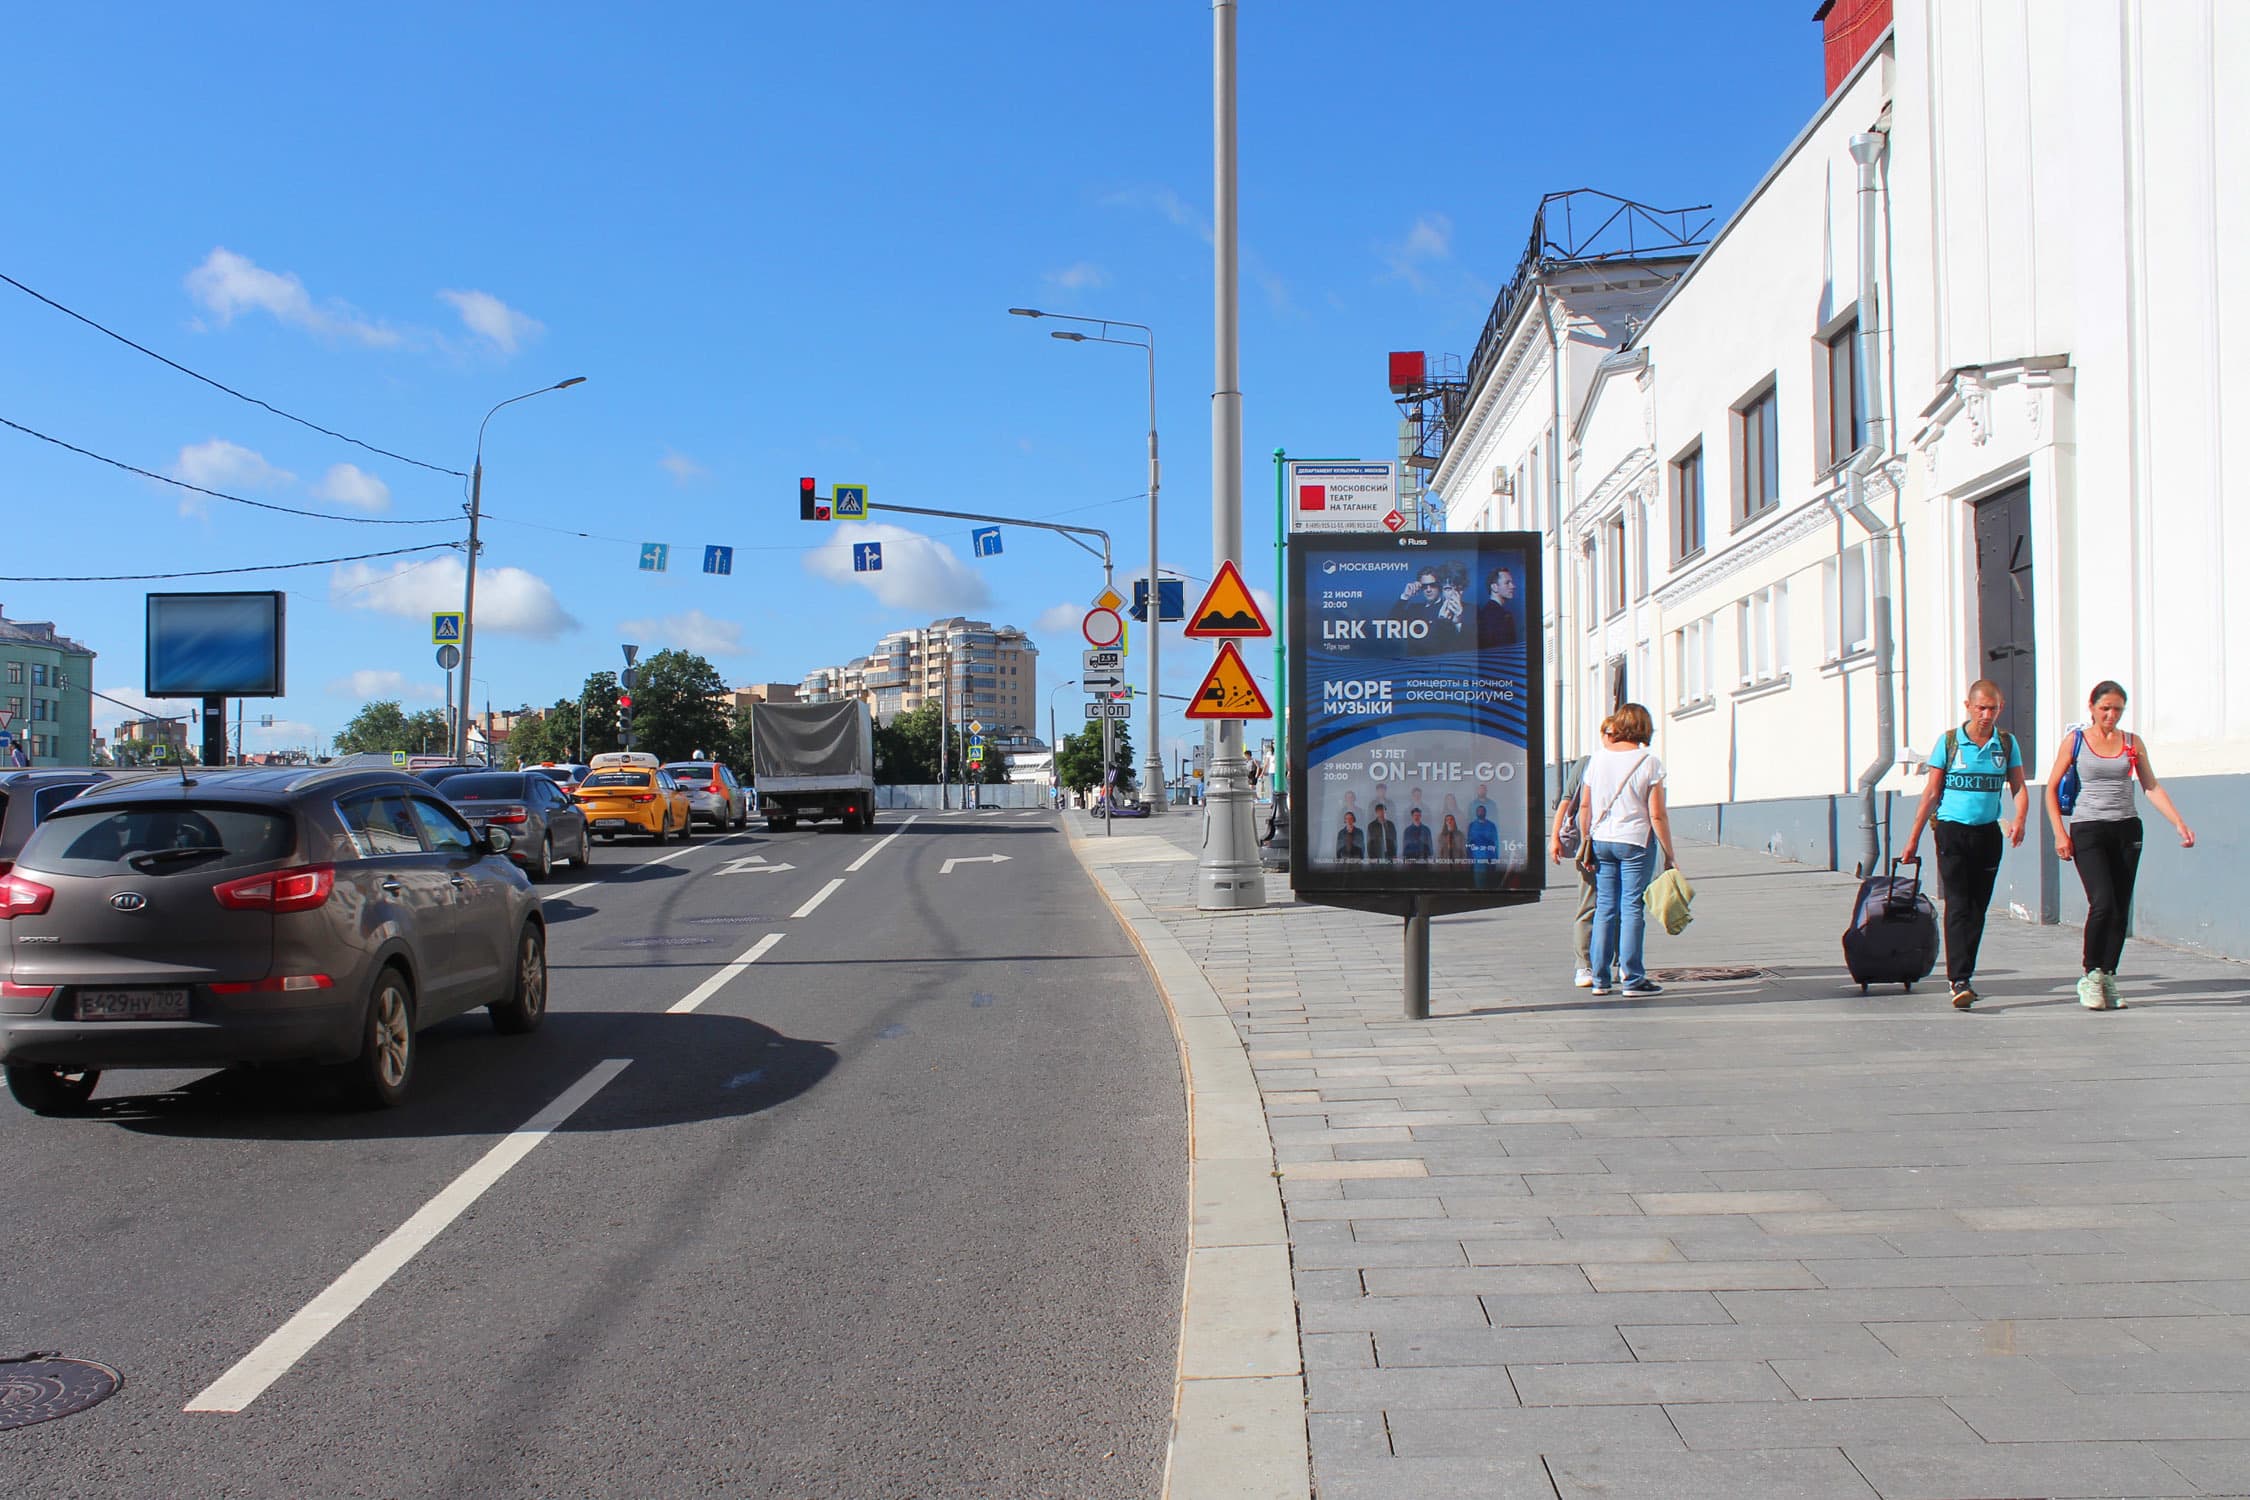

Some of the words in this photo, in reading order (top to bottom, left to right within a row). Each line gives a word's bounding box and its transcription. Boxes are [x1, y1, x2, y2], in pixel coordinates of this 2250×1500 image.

[1330, 483, 1388, 492] МОСКОВСКИЙ
[1330, 494, 1354, 502] ТЕАТР
[1330, 503, 1341, 511] НА
[1343, 503, 1377, 511] ТАГАНКЕ
[1408, 538, 1428, 546] Russ
[1339, 562, 1408, 571] МОСКВАРИУМ
[1323, 591, 1333, 599] 22
[1335, 591, 1363, 599] ИЮЛЯ
[1323, 601, 1348, 609] 20:00
[1323, 620, 1366, 639] LRK
[1406, 680, 1460, 689] концерты
[1323, 680, 1392, 700] МОРЕ
[1406, 689, 1514, 703] океанариуме
[1091, 705, 1124, 716] СОП
[1323, 701, 1392, 715] МУЗЫКИ
[1370, 749, 1383, 759] 15
[1384, 749, 1407, 759] ЛЕТ
[1335, 762, 1363, 770] ИЮЛЯ
[1502, 840, 1525, 851] 16+
[115, 896, 140, 907] KIA
